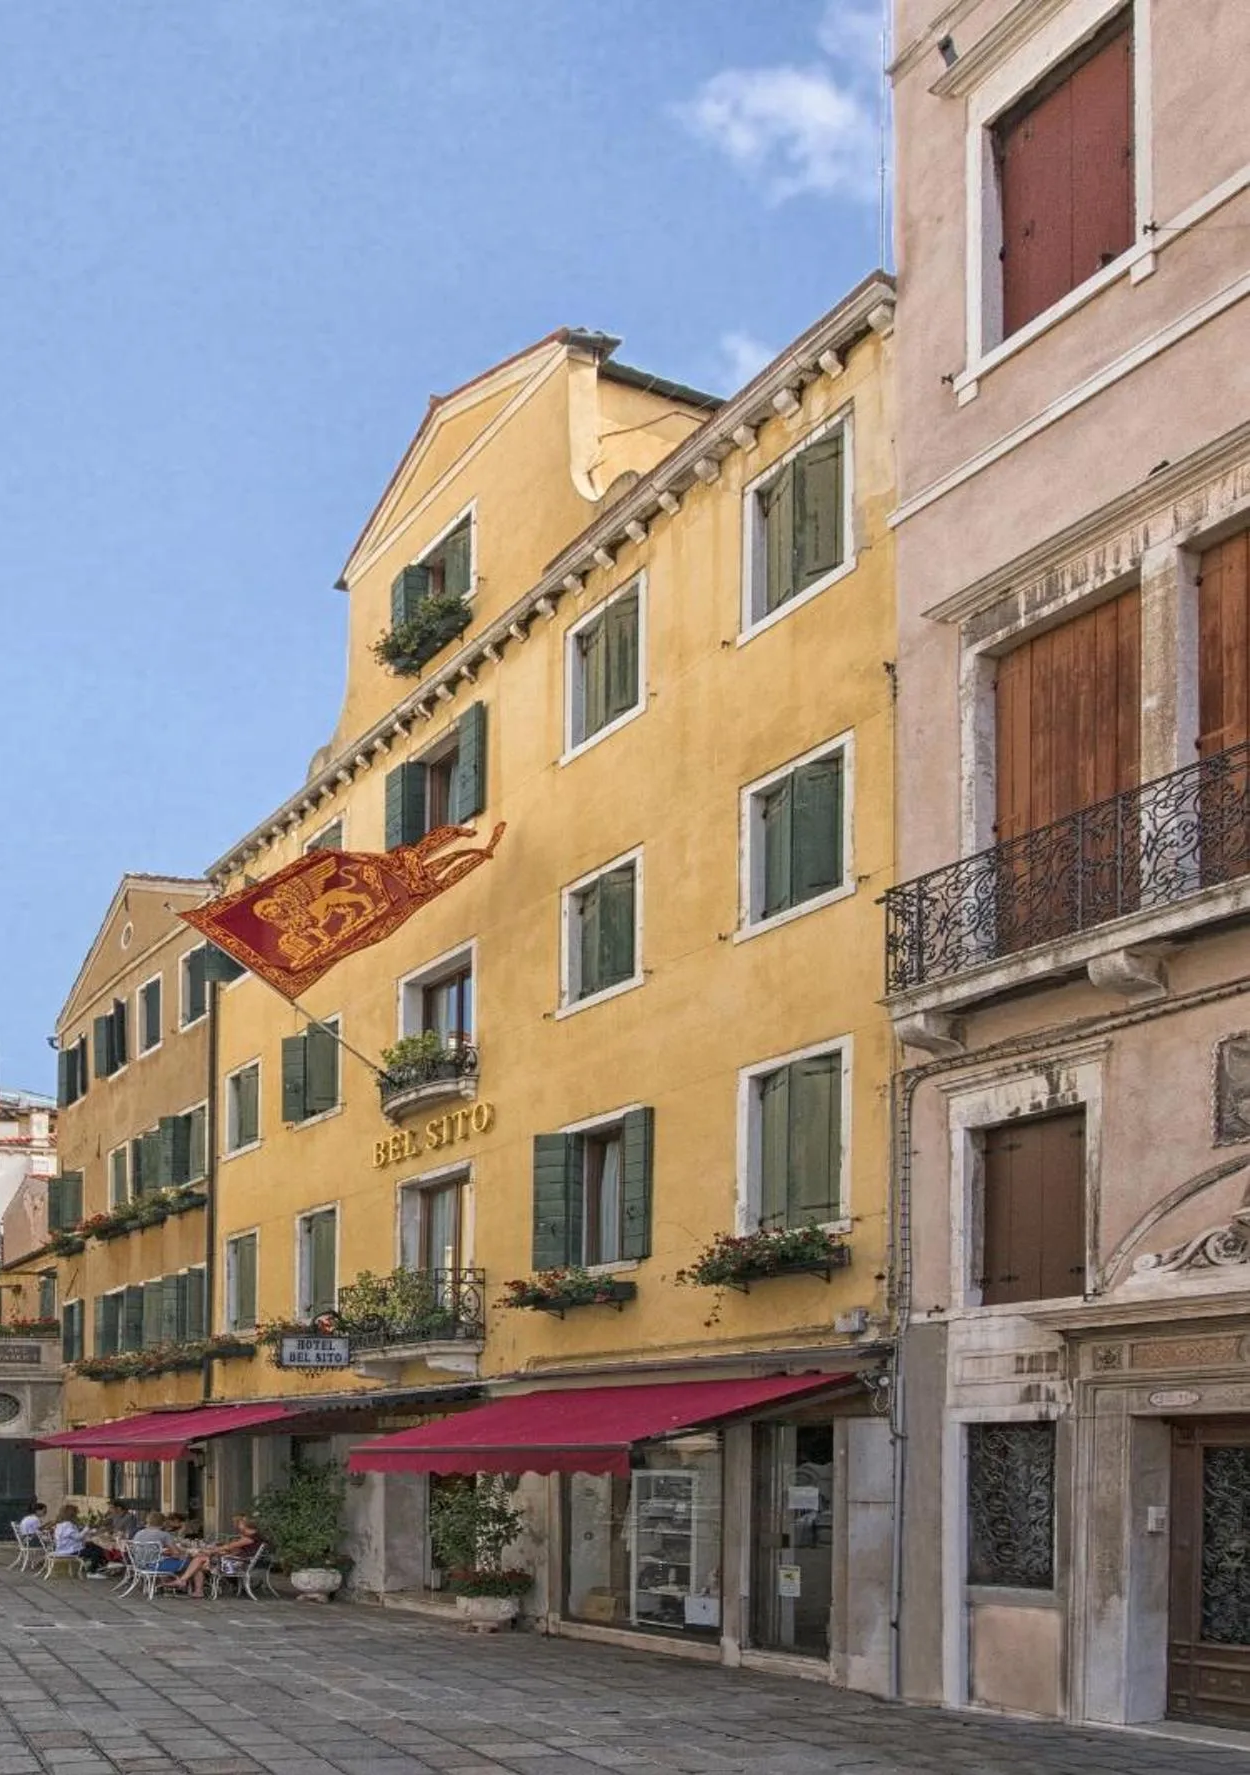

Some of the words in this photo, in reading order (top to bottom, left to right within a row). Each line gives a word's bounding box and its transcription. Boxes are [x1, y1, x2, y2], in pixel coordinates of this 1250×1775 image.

[372, 1129, 421, 1169] BEL
[425, 1101, 495, 1151] SITO
[297, 1339, 336, 1351] HOTEL
[289, 1351, 310, 1362] BEL
[316, 1352, 343, 1363] SITO
